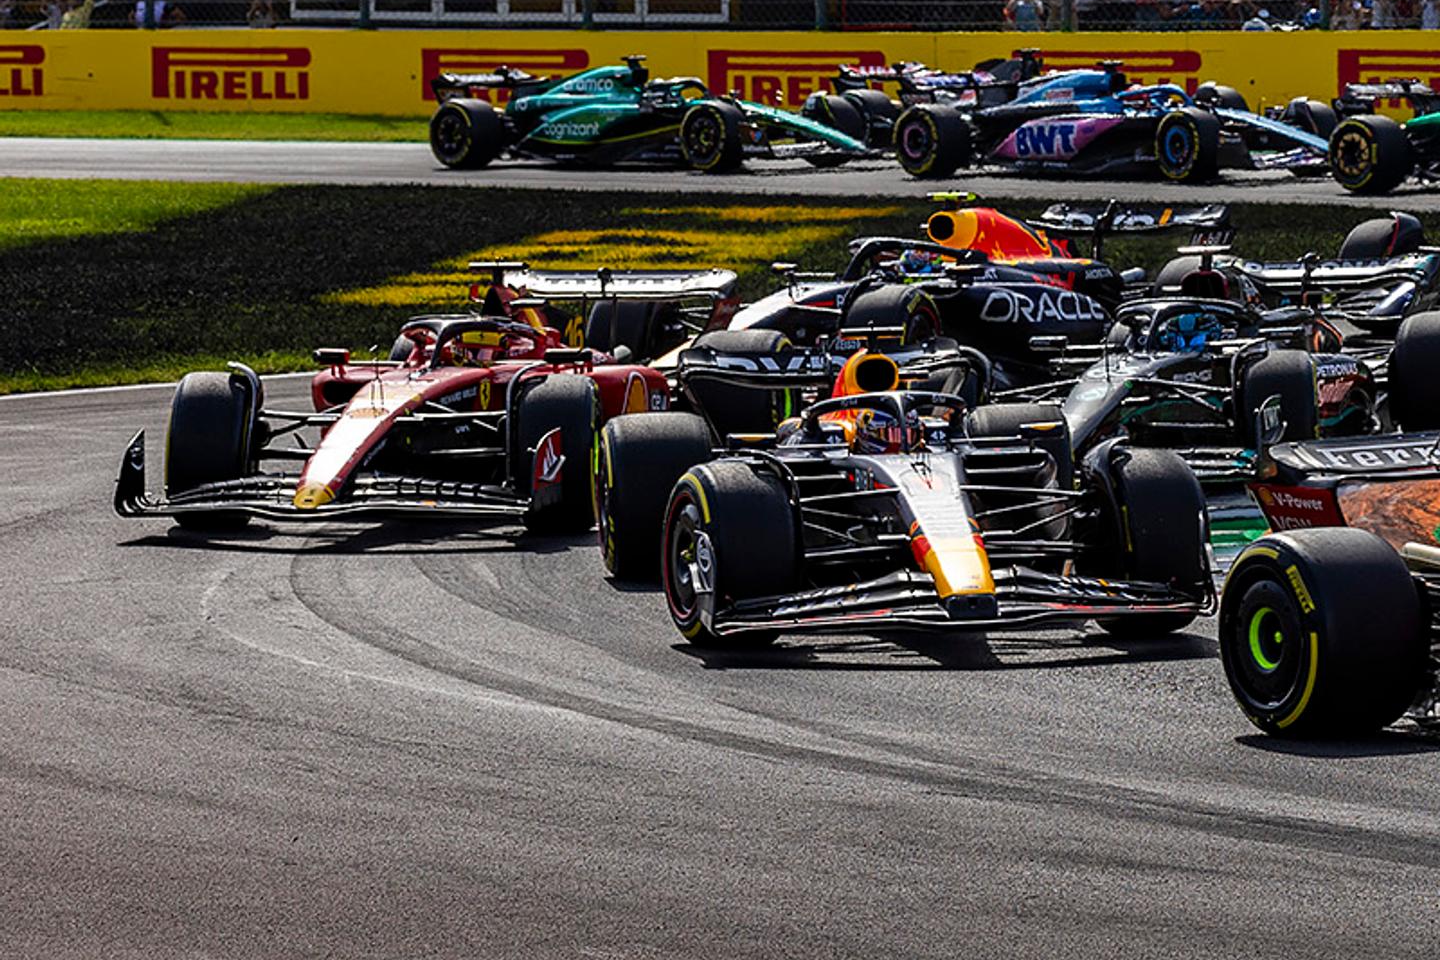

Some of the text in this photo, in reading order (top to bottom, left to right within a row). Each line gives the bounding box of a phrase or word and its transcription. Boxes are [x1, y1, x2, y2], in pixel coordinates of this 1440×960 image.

[151, 46, 312, 100] PIRELLI
[563, 77, 614, 92] aramco
[543, 121, 600, 139] cognizant
[1015, 123, 1077, 157] BWT
[980, 291, 1105, 323] ORACLE
[1273, 491, 1324, 511] V-Power
[1285, 564, 1316, 614] PIRELLI
